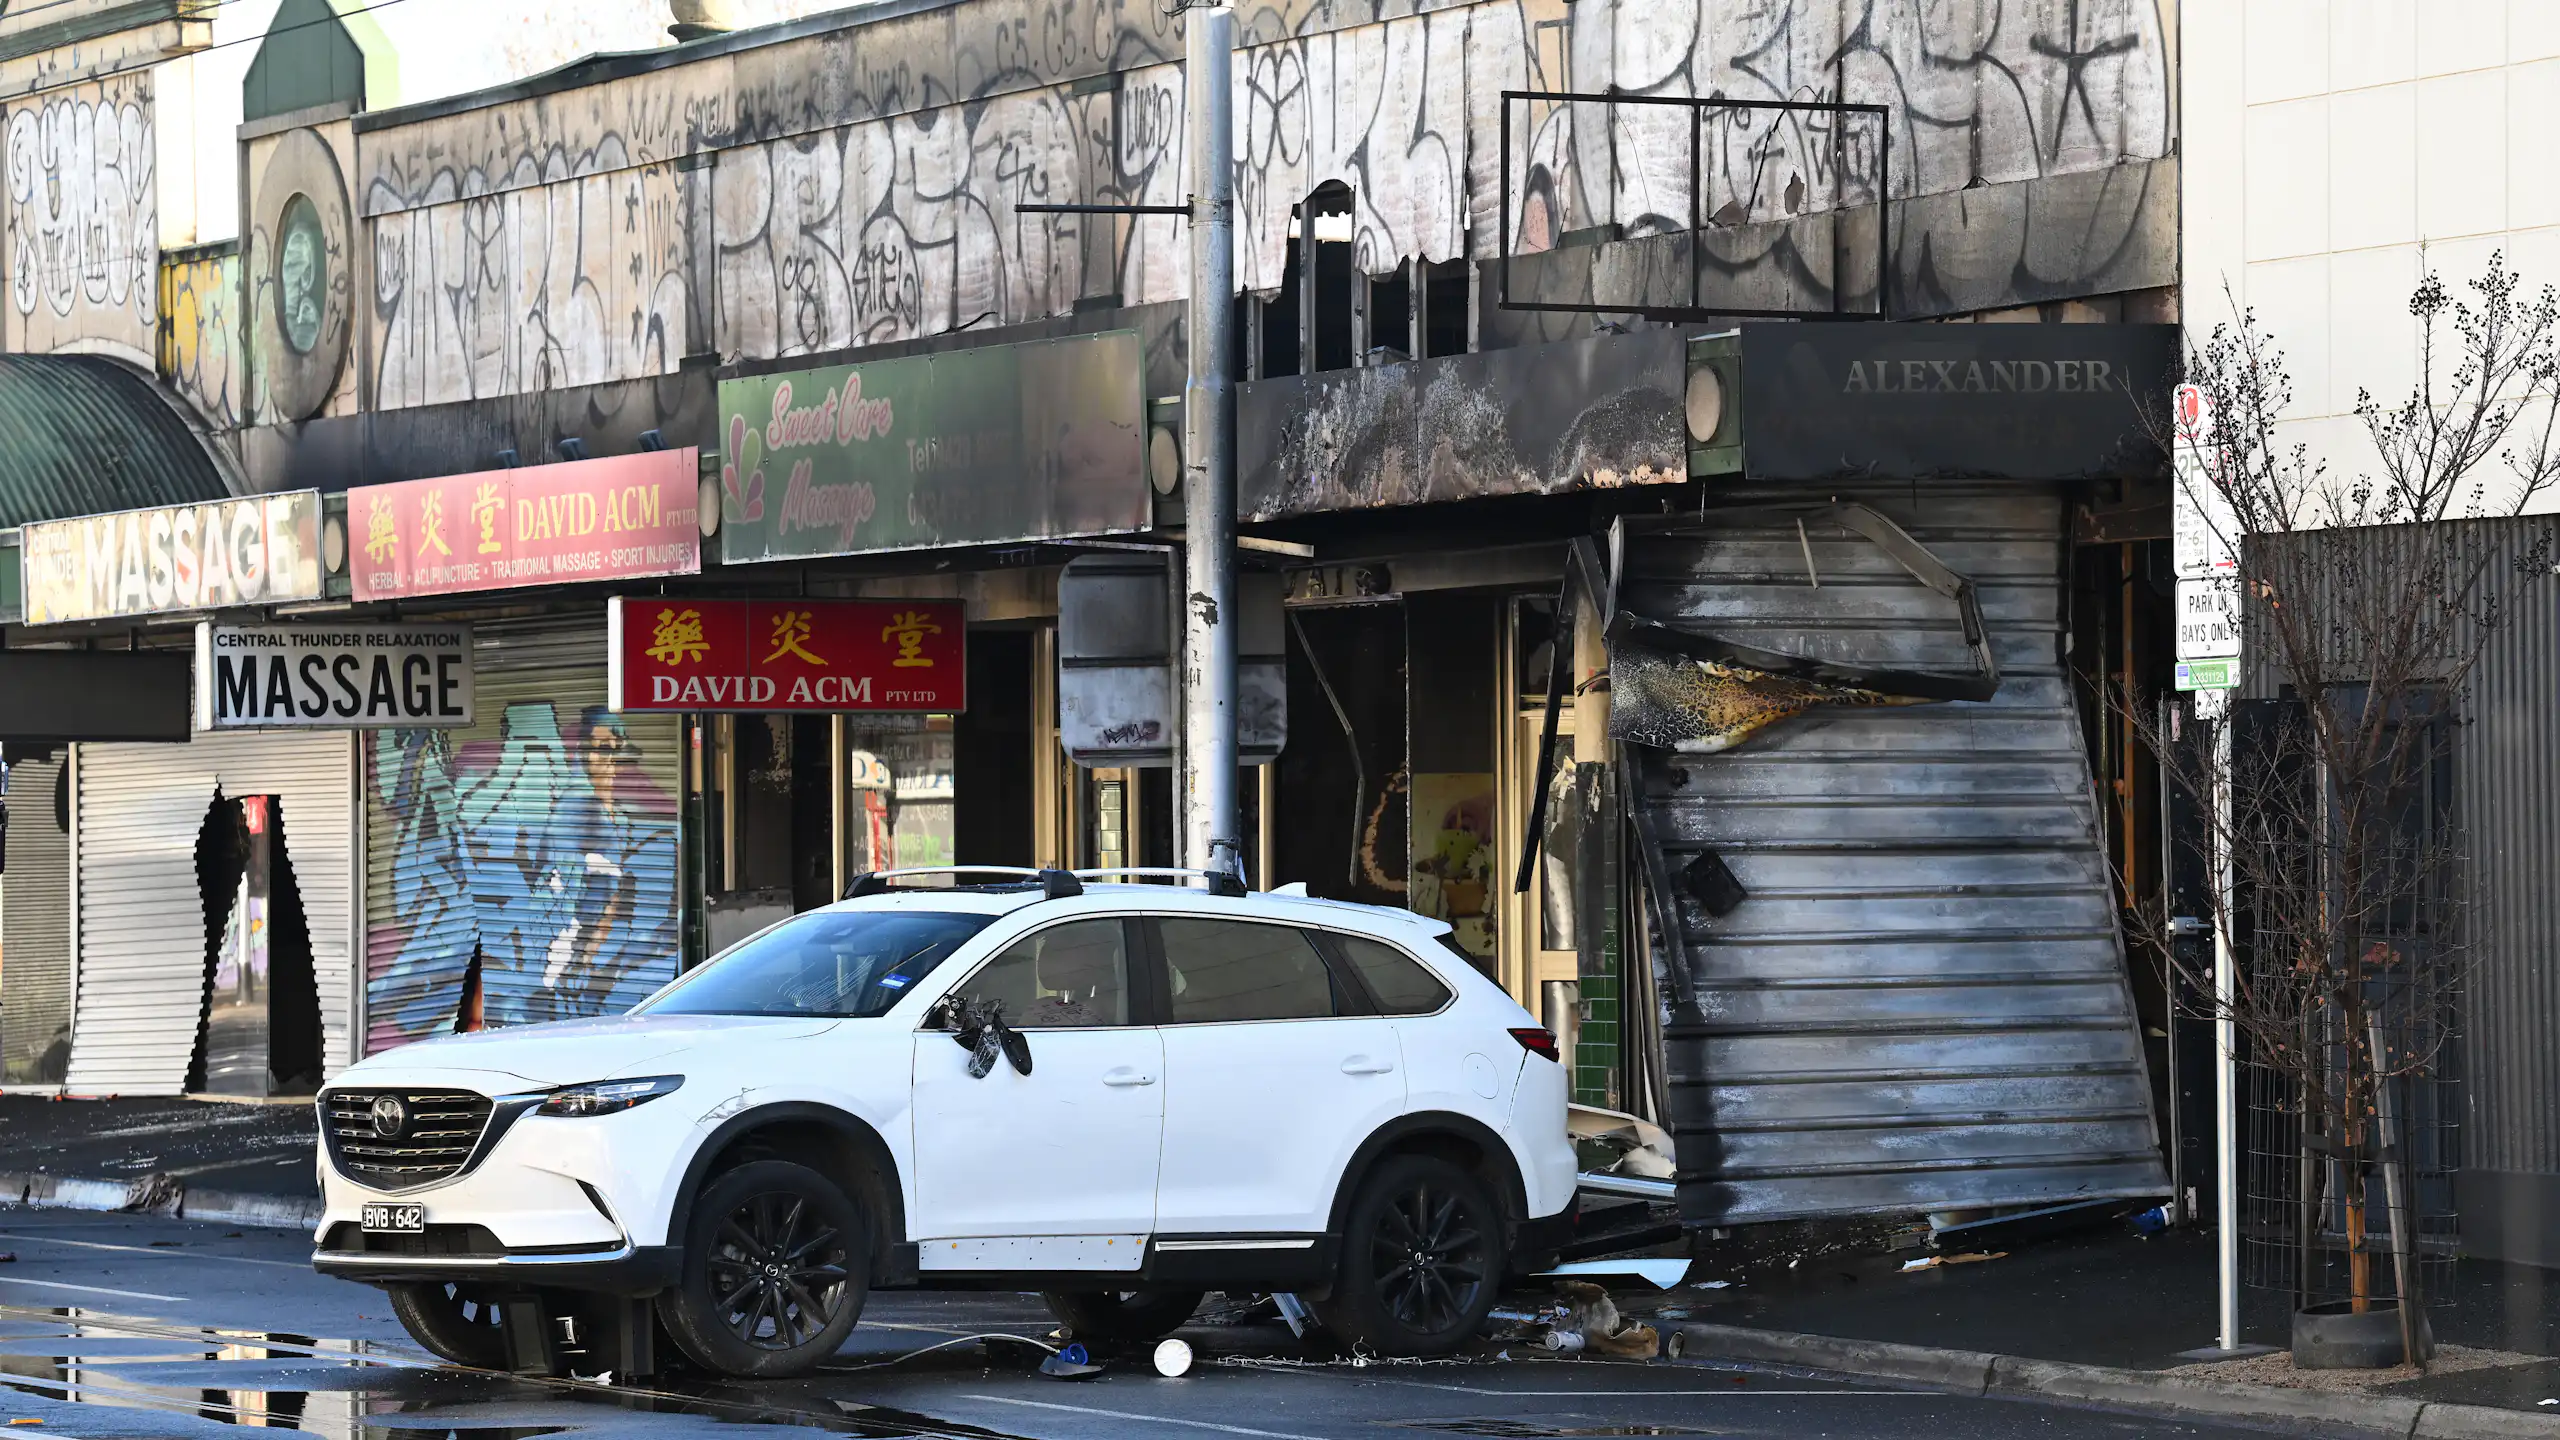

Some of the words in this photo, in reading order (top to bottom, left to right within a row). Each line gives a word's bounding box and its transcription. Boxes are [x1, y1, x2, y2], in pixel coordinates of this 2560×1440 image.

[1843, 360, 2112, 393] ALEXANDER
[766, 379, 838, 451] Sweet
[837, 371, 894, 446] Care
[2178, 453, 2202, 483] 2P
[517, 492, 596, 541] DAVID
[603, 484, 661, 533] ACM
[666, 510, 681, 528] PTY
[682, 507, 697, 526] LTD
[779, 457, 875, 548] Massage
[83, 496, 292, 612] MASSAGE
[367, 571, 404, 590] HERBAL
[414, 562, 480, 586] ACUPUNCTURE
[491, 555, 551, 578] TRADITIONAL
[553, 551, 601, 572] MASSAGE
[611, 546, 643, 568] SPORT
[645, 542, 695, 564] INJURIES
[2189, 594, 2213, 613] PARK
[2218, 593, 2227, 611] IN
[217, 633, 286, 648] CENTRAL
[290, 633, 361, 647] THUNDER
[366, 633, 460, 647] RELAXATION
[645, 608, 942, 667] 藥炎堂
[2182, 623, 2206, 642] BAYS
[217, 654, 464, 718] MASSAGE
[652, 675, 776, 703] DAVID
[786, 676, 873, 703] ACM
[885, 690, 910, 702] PTY
[913, 690, 936, 702] LTD
